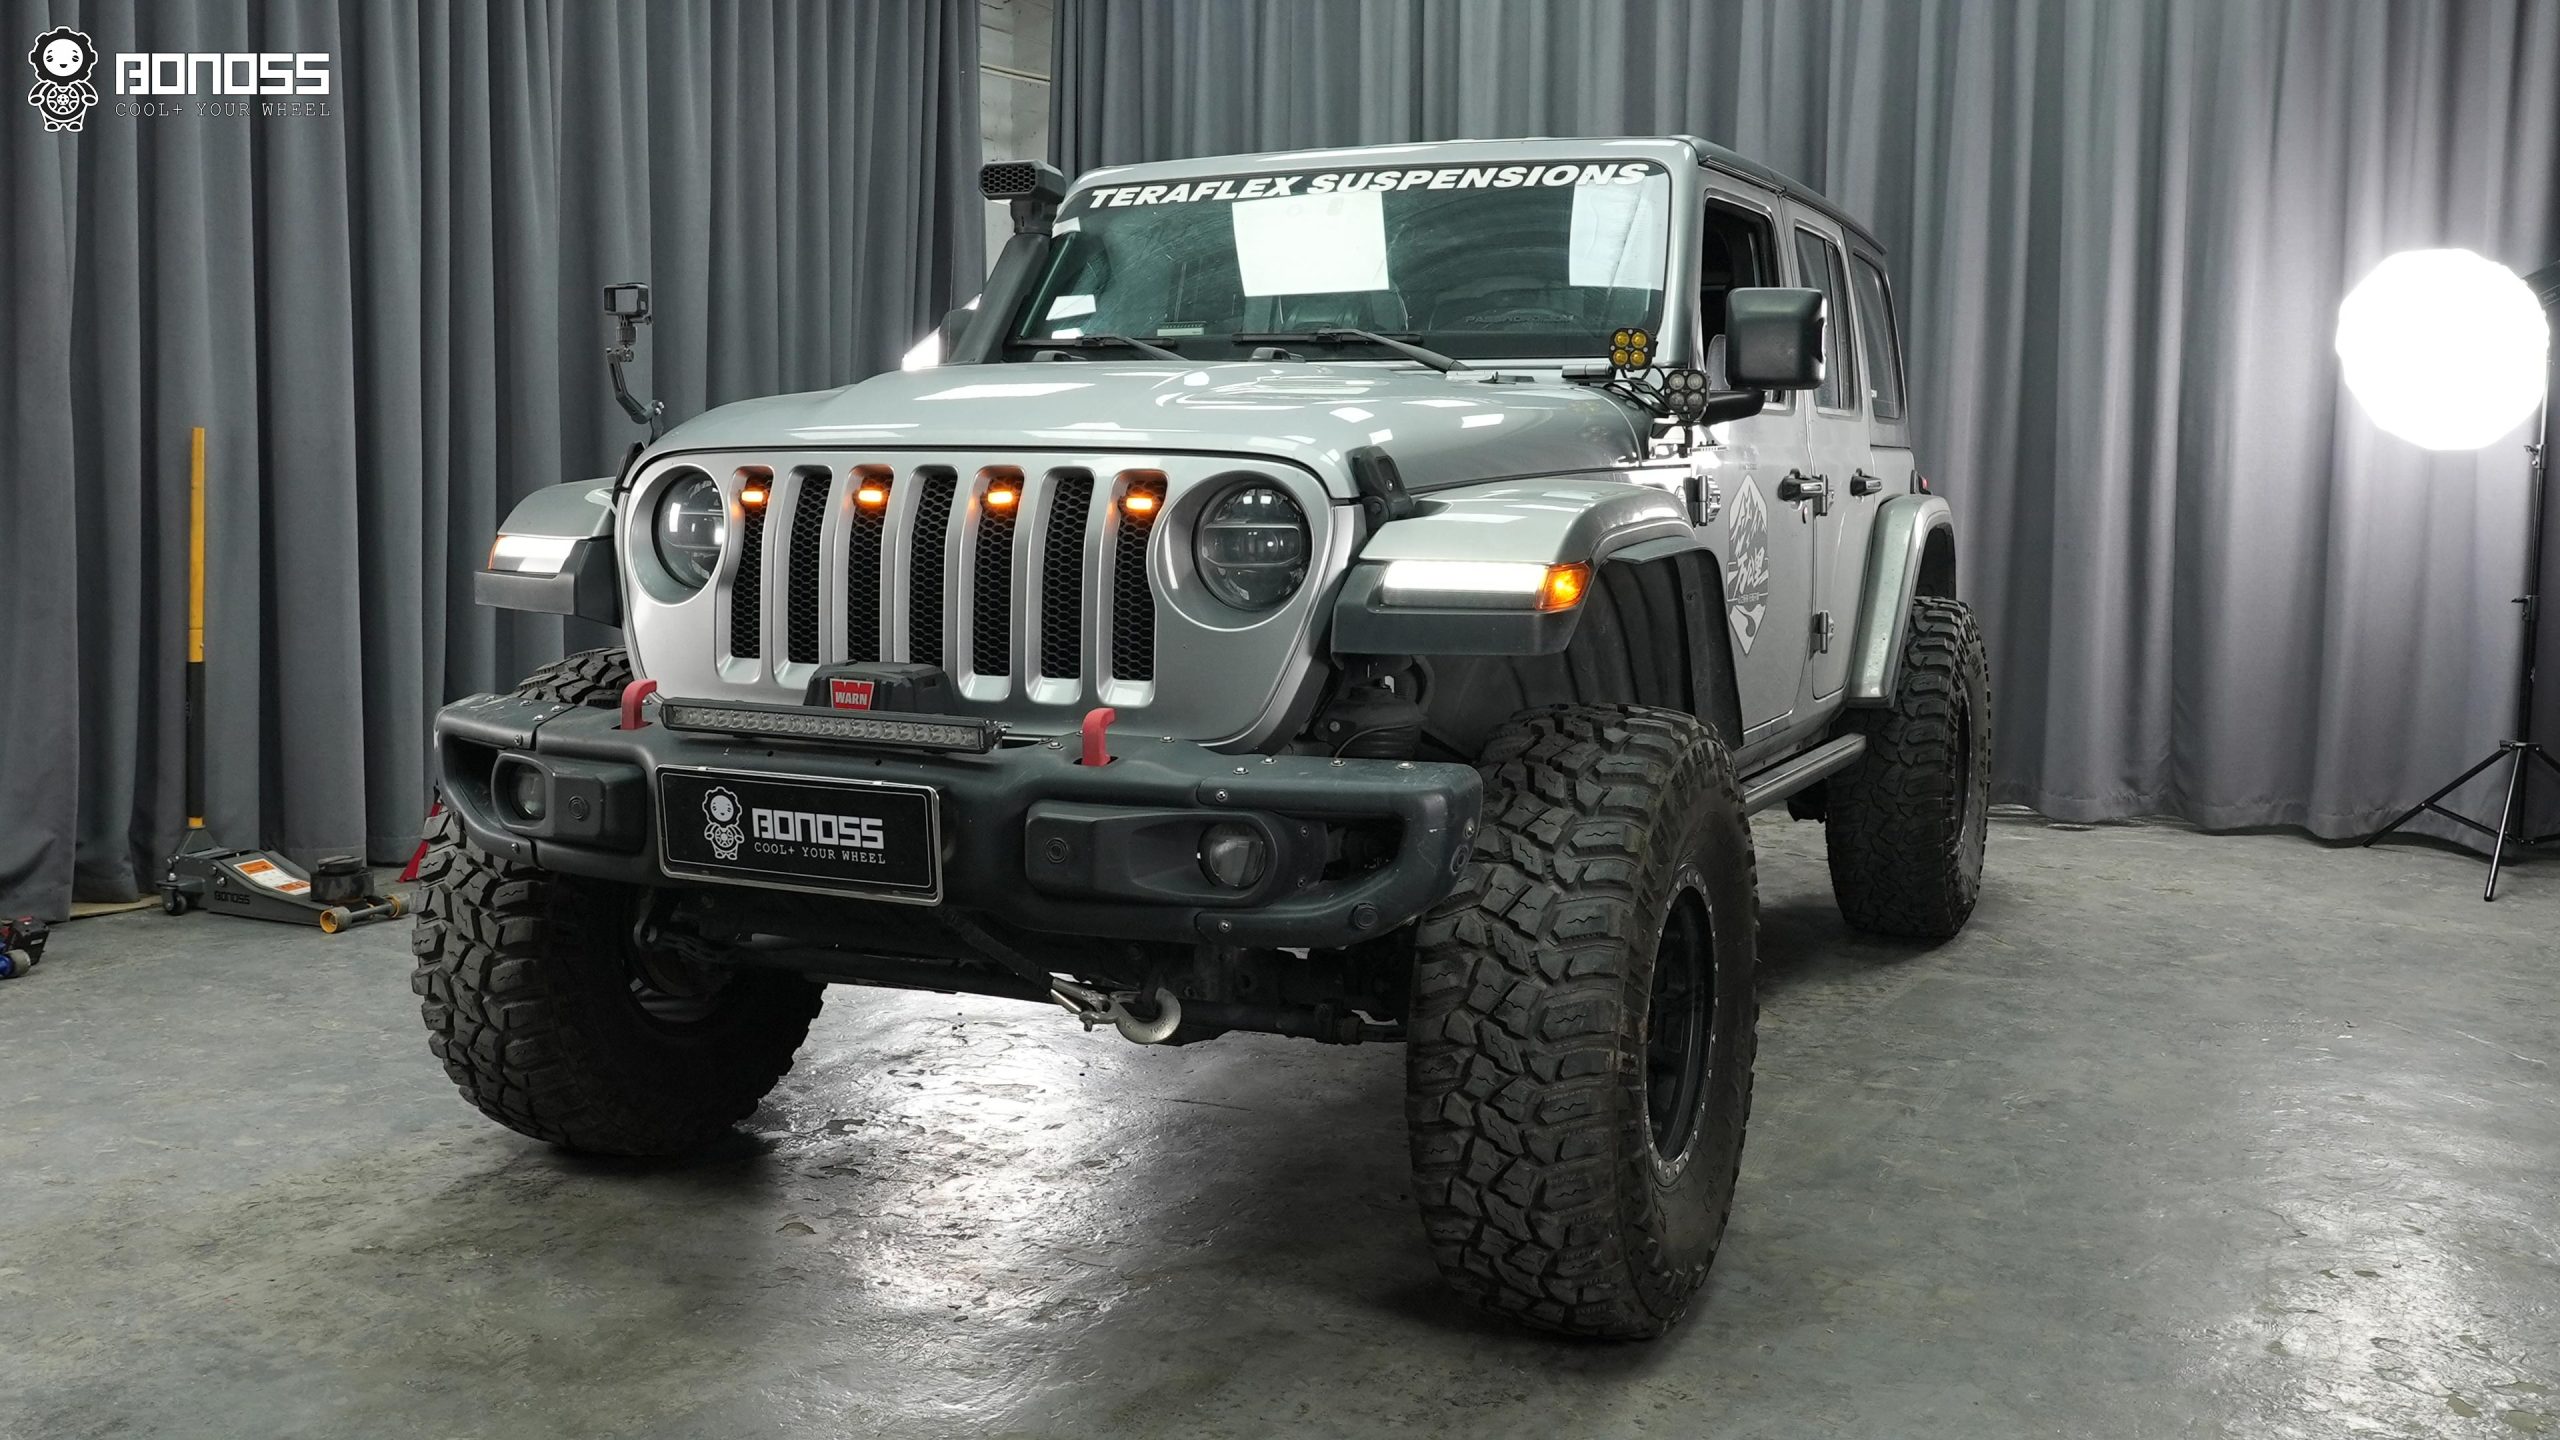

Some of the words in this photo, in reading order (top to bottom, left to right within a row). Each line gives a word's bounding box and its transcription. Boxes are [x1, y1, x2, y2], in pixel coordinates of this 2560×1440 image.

[1089, 176, 1303, 209] TERAFLEX
[1306, 163, 1650, 193] SUSPENSIONS
[835, 691, 868, 705] WARN
[751, 807, 885, 850] BONOSS
[754, 841, 796, 856] COOL+
[801, 846, 836, 860] YOUR
[841, 850, 886, 865] WHEEL
